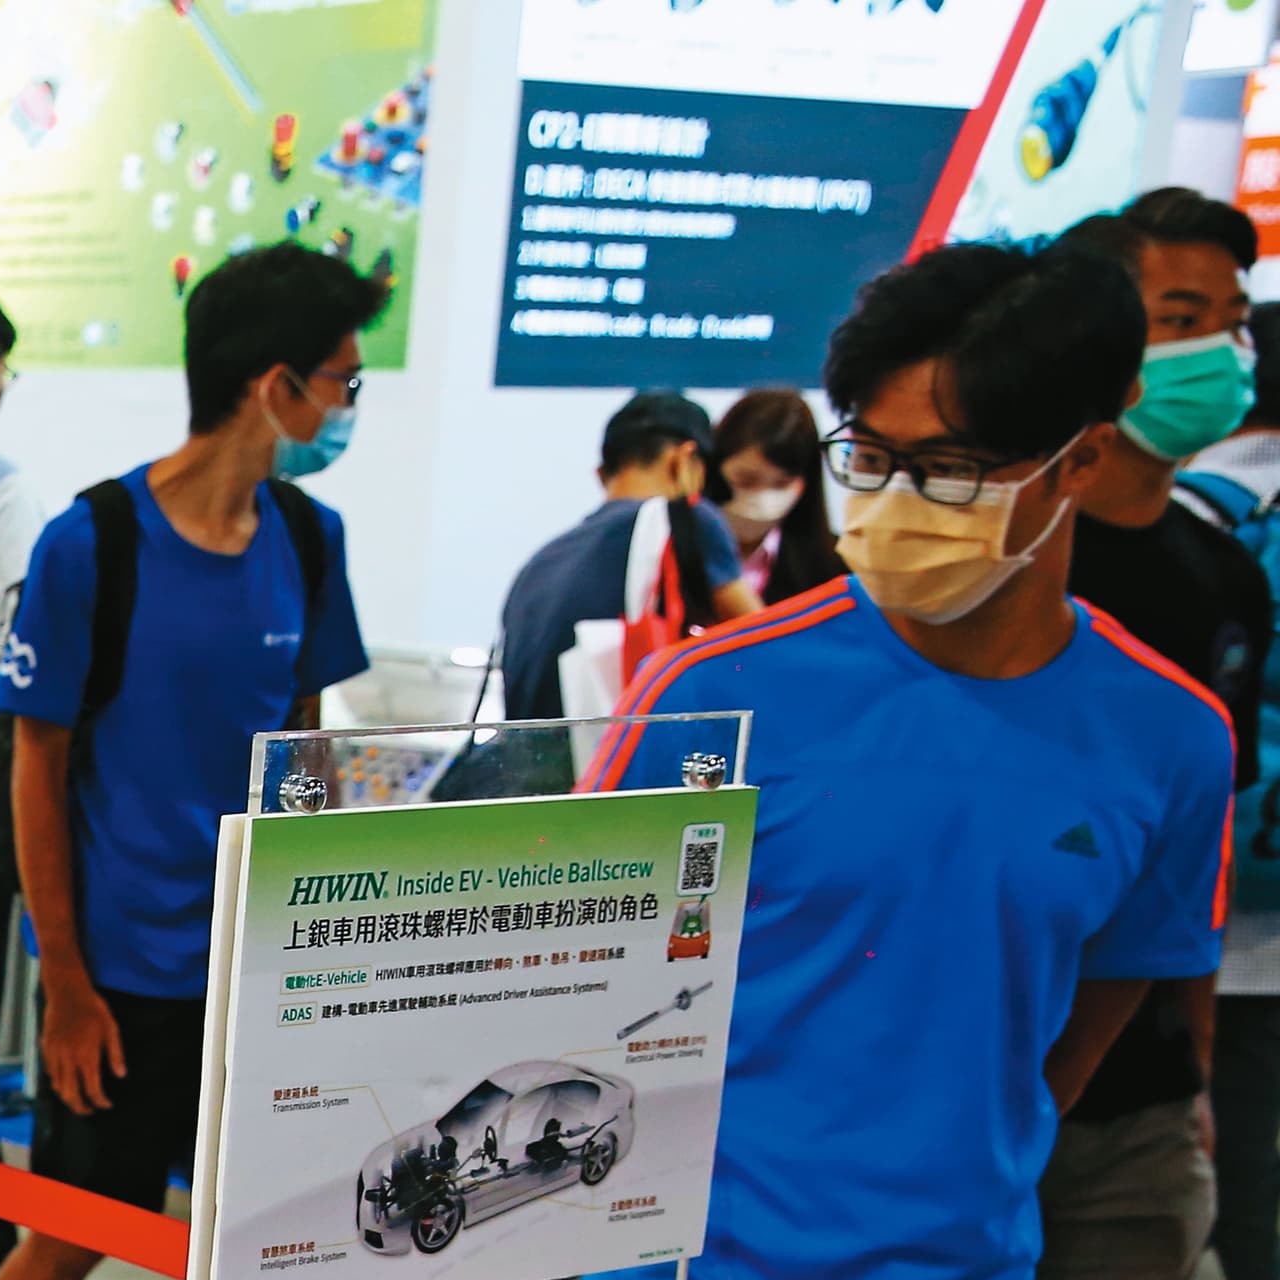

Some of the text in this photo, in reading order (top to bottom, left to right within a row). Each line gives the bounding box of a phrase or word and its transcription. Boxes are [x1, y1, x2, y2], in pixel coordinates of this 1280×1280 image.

[288, 871, 389, 906] HIWIN
[396, 870, 453, 897] Inside
[459, 869, 484, 892] EV
[497, 864, 564, 888] Vehicle
[567, 859, 654, 883] Ballscrew
[283, 892, 659, 950] 上銀車用滾珠螺桿於電動車扮演的角色
[459, 989, 501, 1006] (Advanced
[503, 987, 528, 1001] Driver
[529, 984, 571, 998] Assistance
[573, 980, 608, 995] Systems)
[281, 1007, 312, 1022] ADAS
[272, 1097, 349, 1112] Transmission System
[298, 1254, 319, 1265] Brake
[321, 1251, 347, 1264] System
